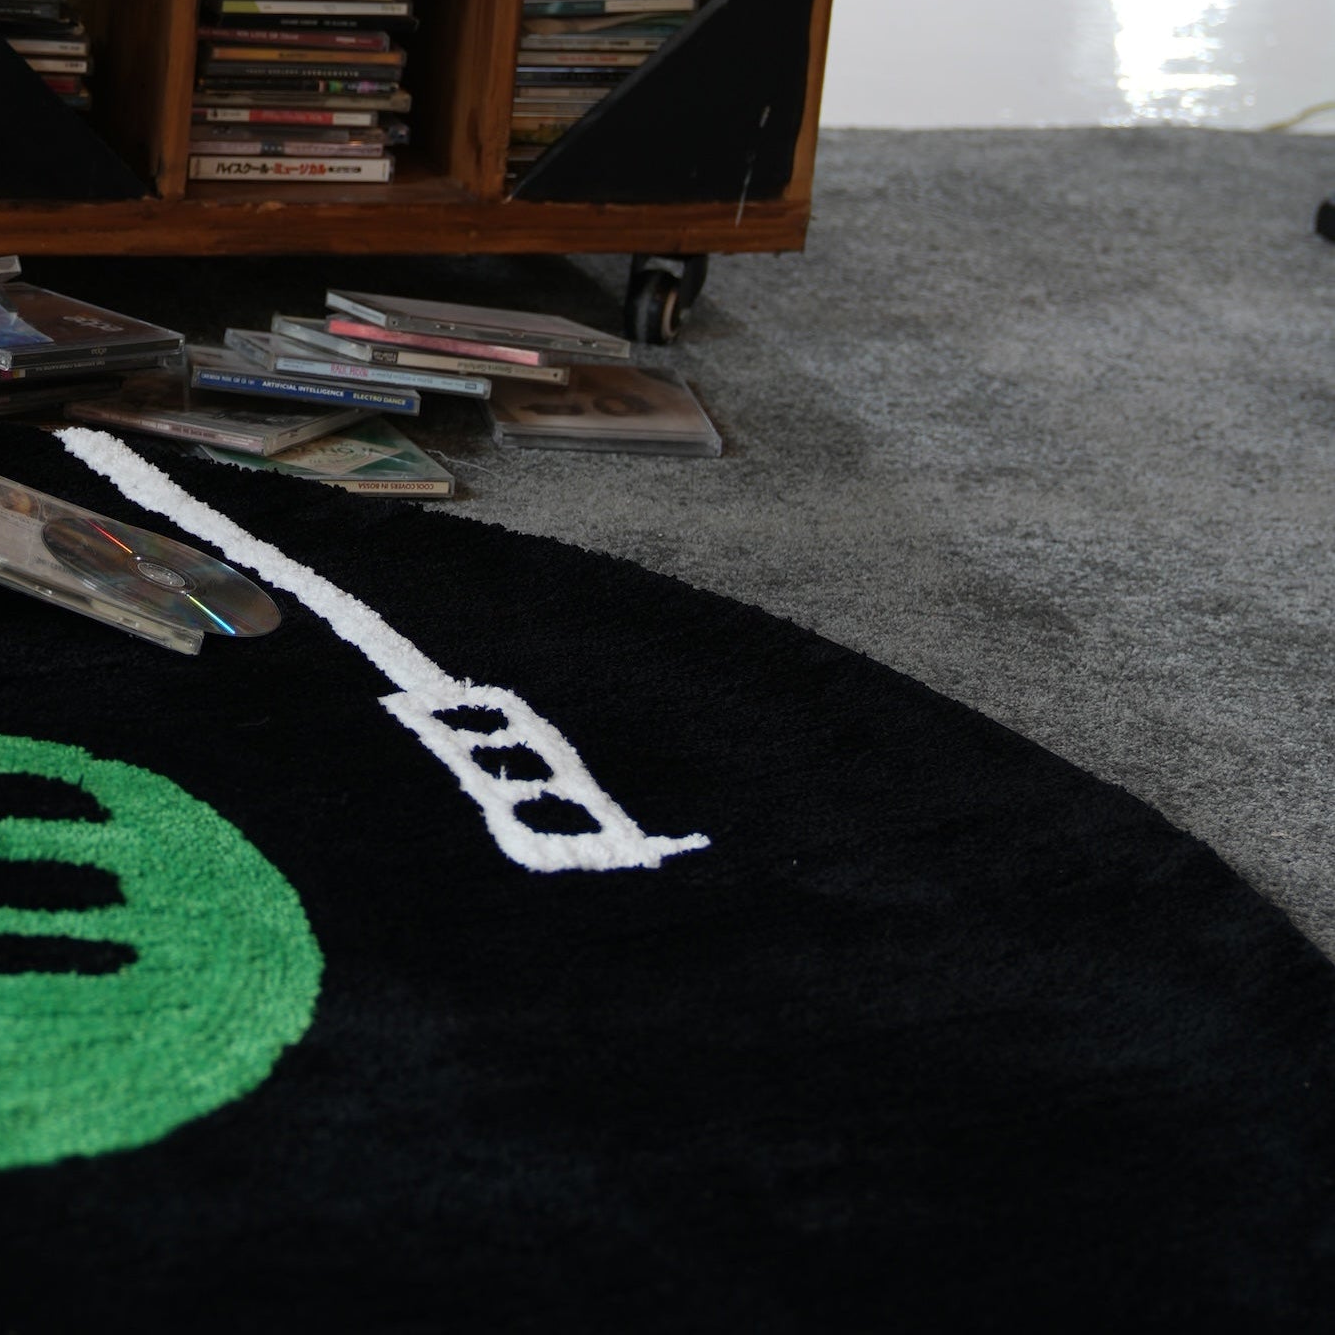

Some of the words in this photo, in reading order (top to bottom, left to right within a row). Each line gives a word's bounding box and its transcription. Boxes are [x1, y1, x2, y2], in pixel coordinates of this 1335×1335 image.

[261, 380, 297, 393] ARTIFICIAL
[297, 384, 345, 398] INTELLIGENCE
[353, 392, 384, 404] ELECTRO
[385, 396, 406, 407] DANCE
[358, 482, 380, 490] BOSSA
[381, 482, 389, 490] IN
[391, 482, 415, 490] COVERS
